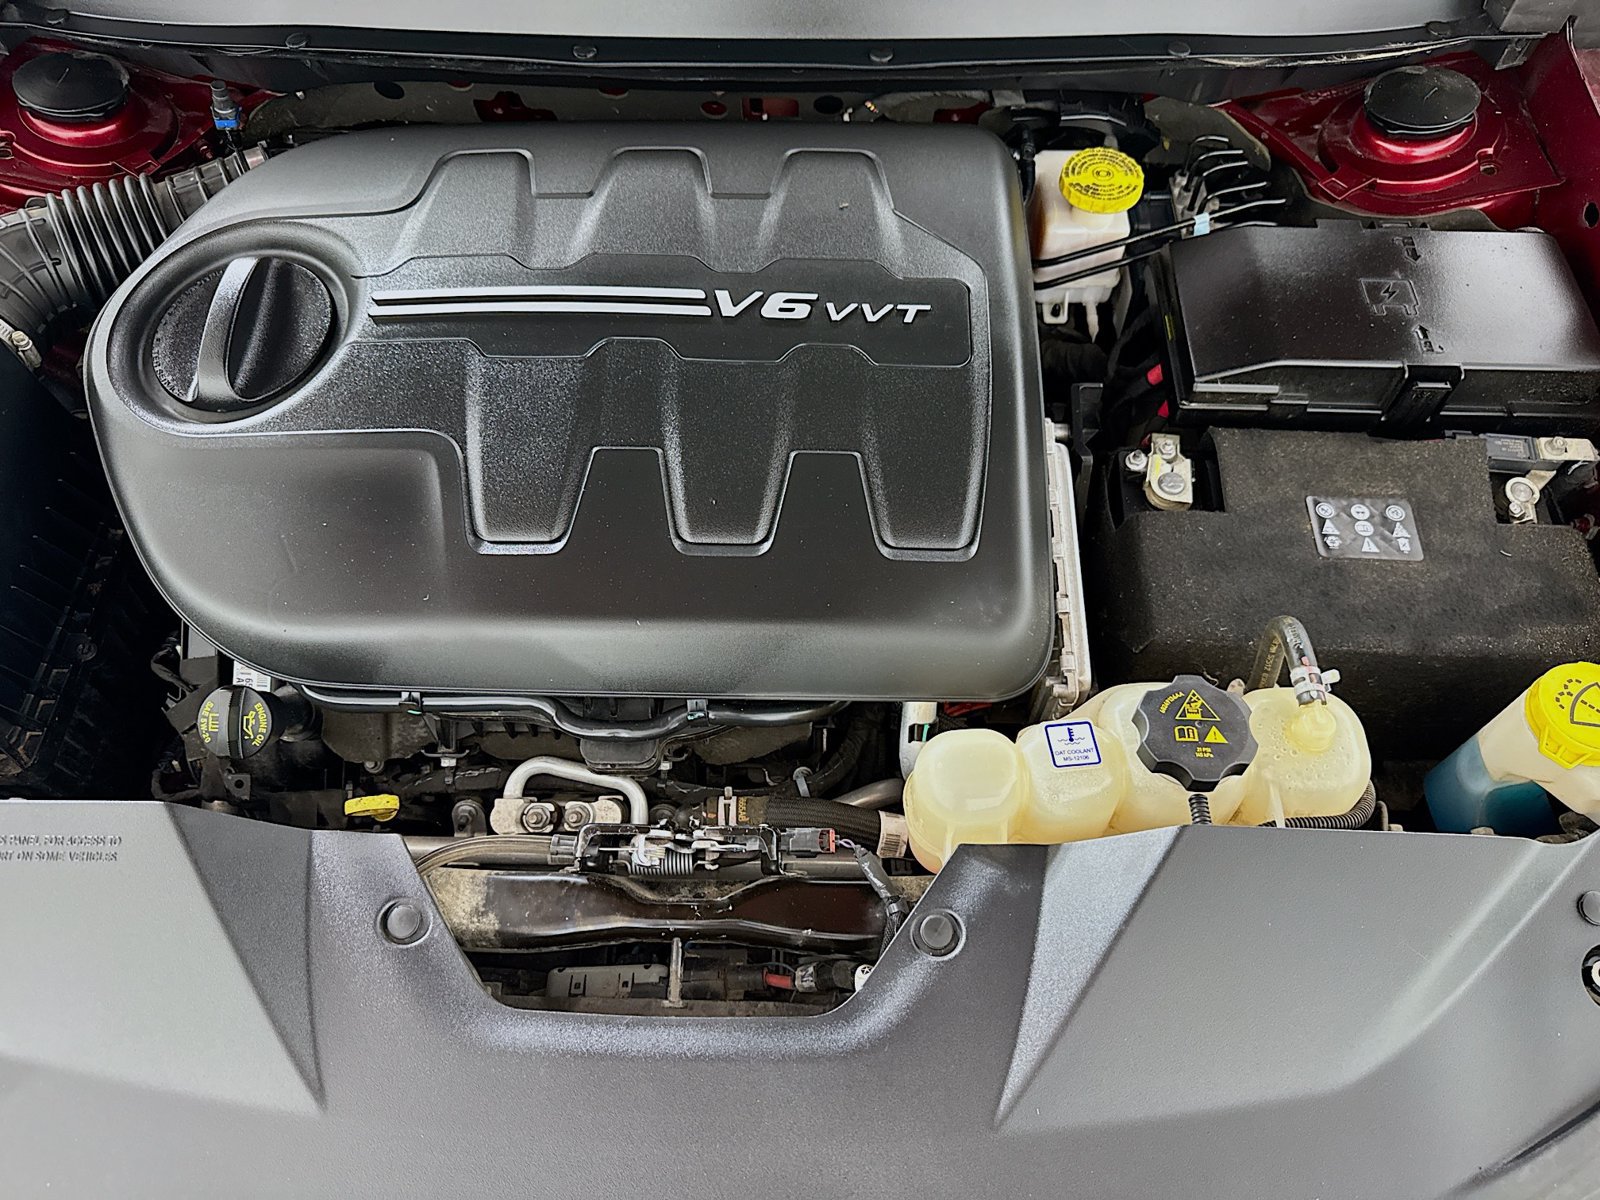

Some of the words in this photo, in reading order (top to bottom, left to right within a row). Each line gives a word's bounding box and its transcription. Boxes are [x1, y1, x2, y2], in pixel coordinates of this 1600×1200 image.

[714, 289, 819, 320] V6
[825, 302, 932, 324] VVT
[201, 701, 214, 716] SAE
[254, 702, 267, 734] ENGINE
[200, 718, 212, 744] 5W-20
[251, 734, 265, 747] OIL
[1067, 747, 1094, 755] COOLANT
[9, 834, 41, 846] PANEL
[44, 834, 65, 846] FOR
[66, 834, 106, 846] ACCESS
[107, 834, 122, 847] TO
[17, 850, 34, 861] ON
[35, 850, 66, 862] SOME
[68, 850, 118, 862] VEHICLES
